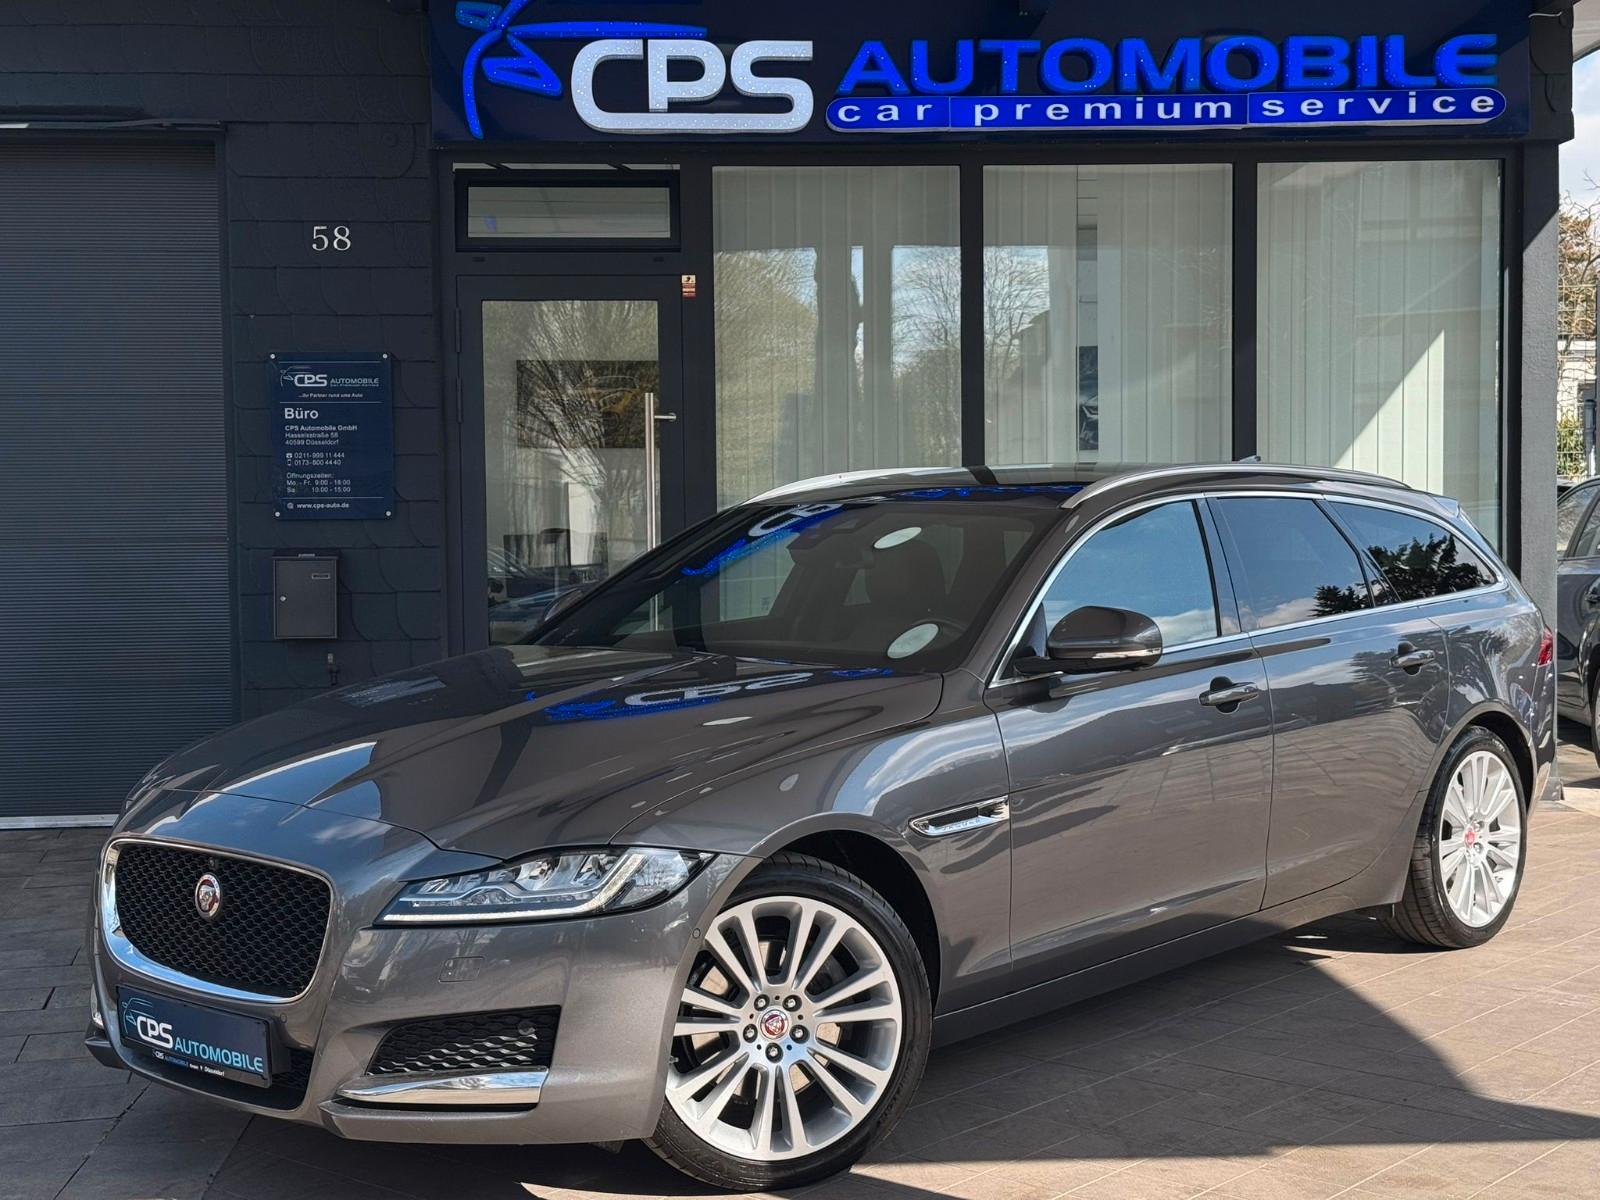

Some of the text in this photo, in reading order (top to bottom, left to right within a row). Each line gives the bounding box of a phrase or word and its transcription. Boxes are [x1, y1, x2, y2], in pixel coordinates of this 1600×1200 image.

[571, 33, 1498, 133] CPS AUTOMOBILE
[837, 90, 1496, 127] car premium service
[312, 225, 352, 251] 58
[294, 374, 328, 387] CPS
[284, 407, 319, 419] Büro
[296, 502, 349, 510] www.cps-auto.de
[136, 1015, 264, 1073] CPS AUTOMOBILE
